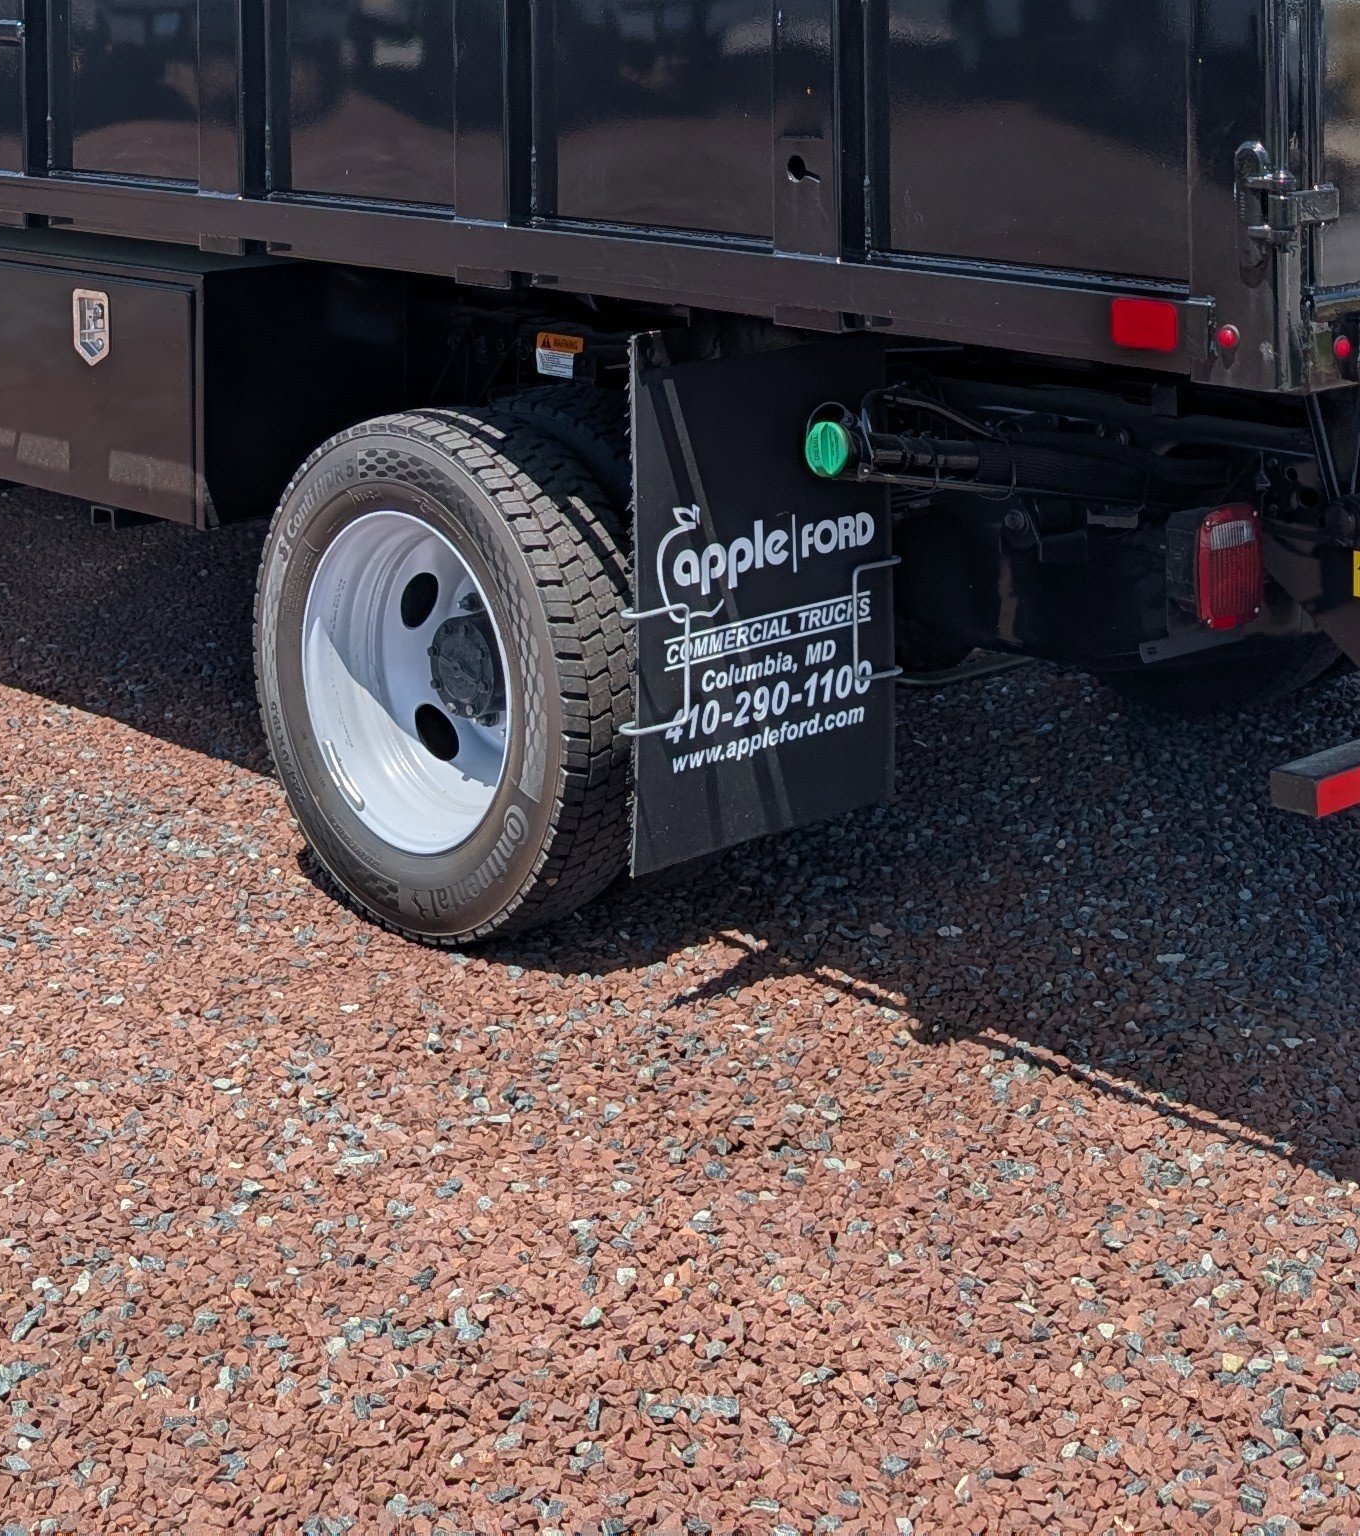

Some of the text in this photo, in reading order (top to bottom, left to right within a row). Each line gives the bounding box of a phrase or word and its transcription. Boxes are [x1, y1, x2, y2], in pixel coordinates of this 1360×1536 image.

[673, 512, 875, 595] apple FORD
[666, 616, 792, 665] COMMERCIAL
[701, 639, 837, 692] Columbia, MD
[665, 660, 873, 744] 410-290-1100
[672, 706, 865, 774] www.appleford.com
[427, 804, 530, 919] Continental
